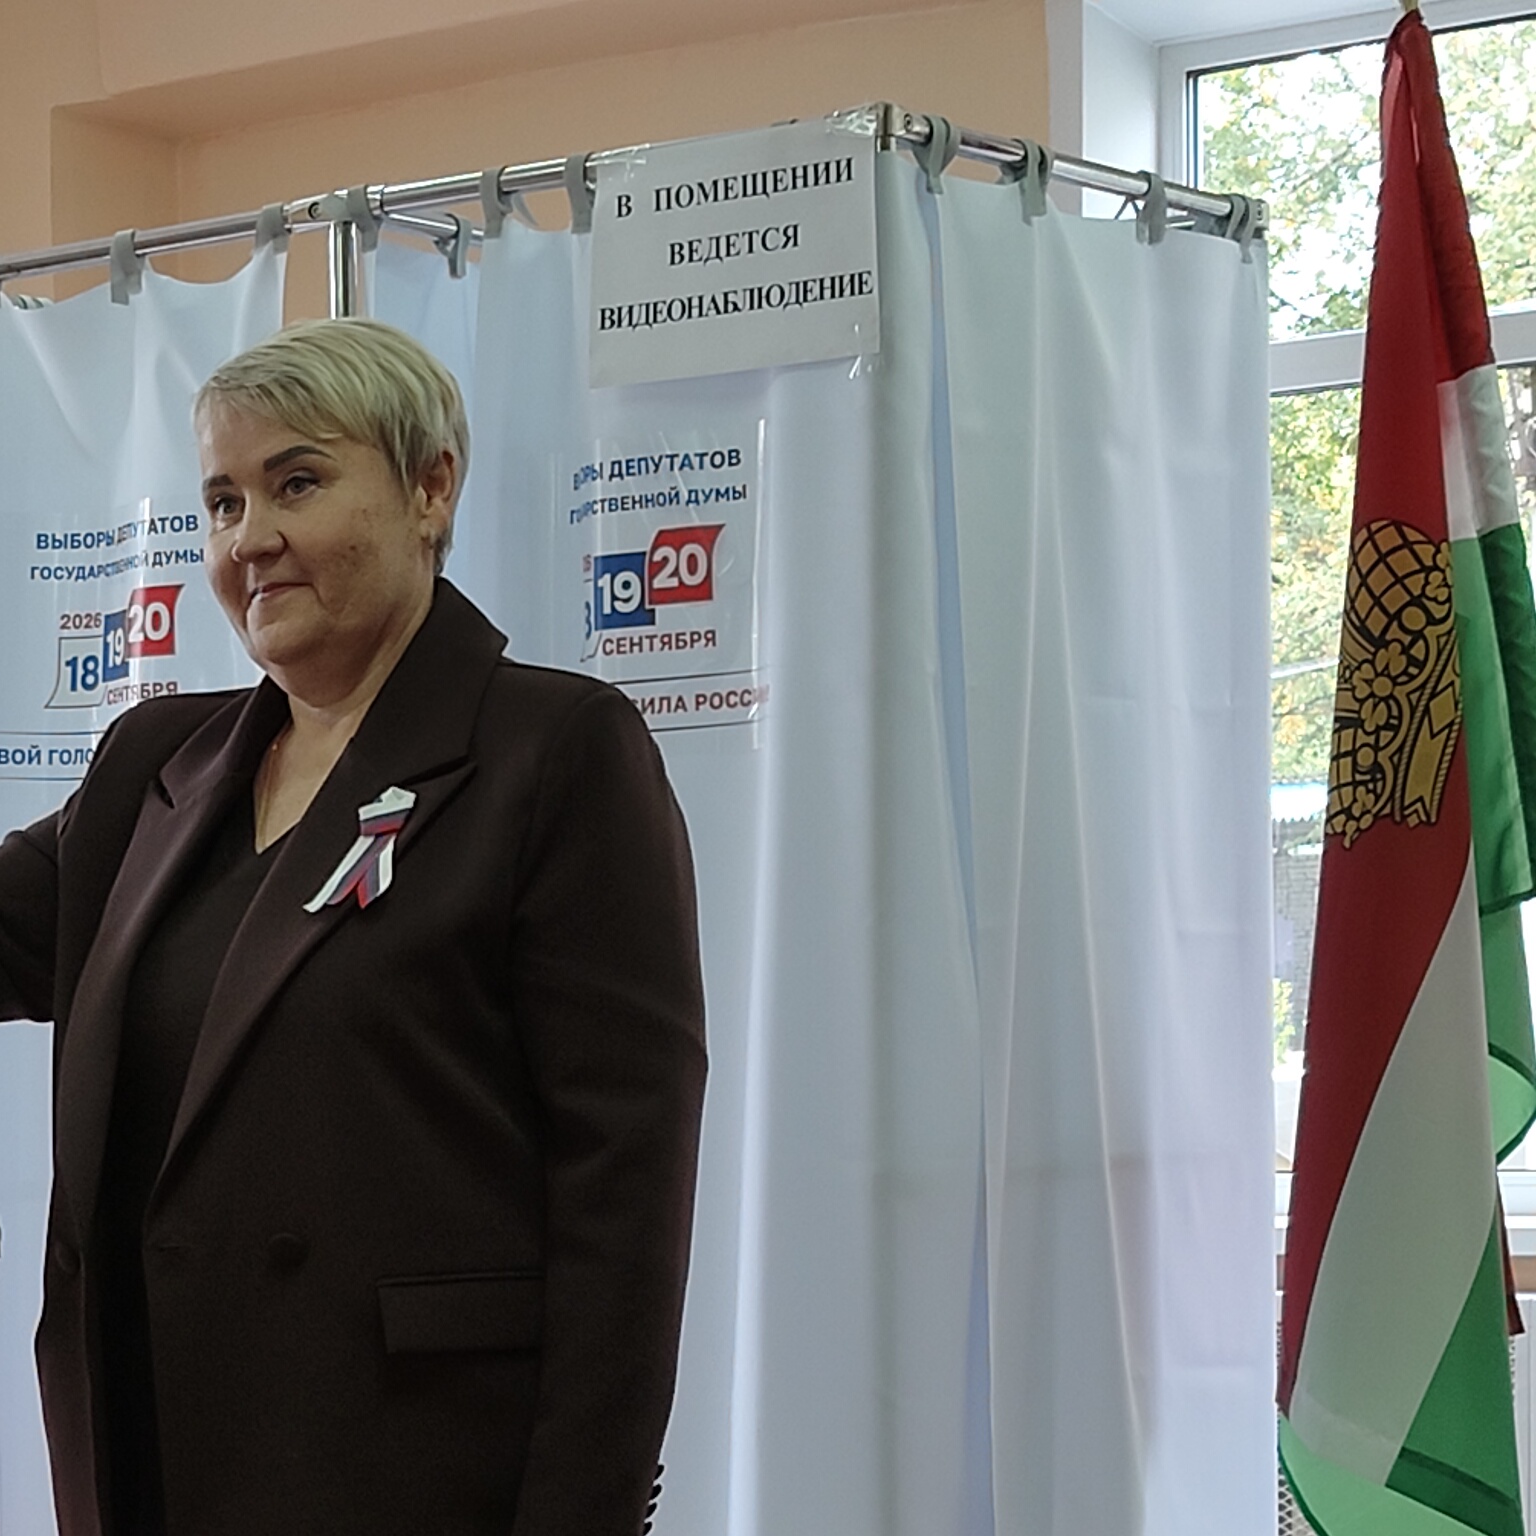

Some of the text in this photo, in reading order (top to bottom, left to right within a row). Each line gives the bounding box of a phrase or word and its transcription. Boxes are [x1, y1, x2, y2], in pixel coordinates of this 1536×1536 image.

[616, 157, 855, 218] В ПОМЕЩЕНИИ
[668, 223, 800, 266] ВЕДЕТСЯ
[598, 270, 874, 331] ВИДЕОНАБЛЮДЕНИЕ
[608, 448, 742, 482] ДЕПУТАТОВ
[685, 484, 747, 507] ДУМЫ
[36, 530, 115, 550] ВЫБОРЫ
[151, 548, 205, 569] ДУМЫ
[651, 542, 709, 590] 20
[596, 570, 643, 616] 19
[60, 613, 102, 630] 2026
[127, 601, 170, 644] 20
[105, 627, 125, 668] 19
[601, 629, 717, 657] СЕНТЯБРЯ
[65, 655, 99, 692] 18
[632, 695, 688, 716] ИЛА
[48, 748, 95, 766] ГОЛО
